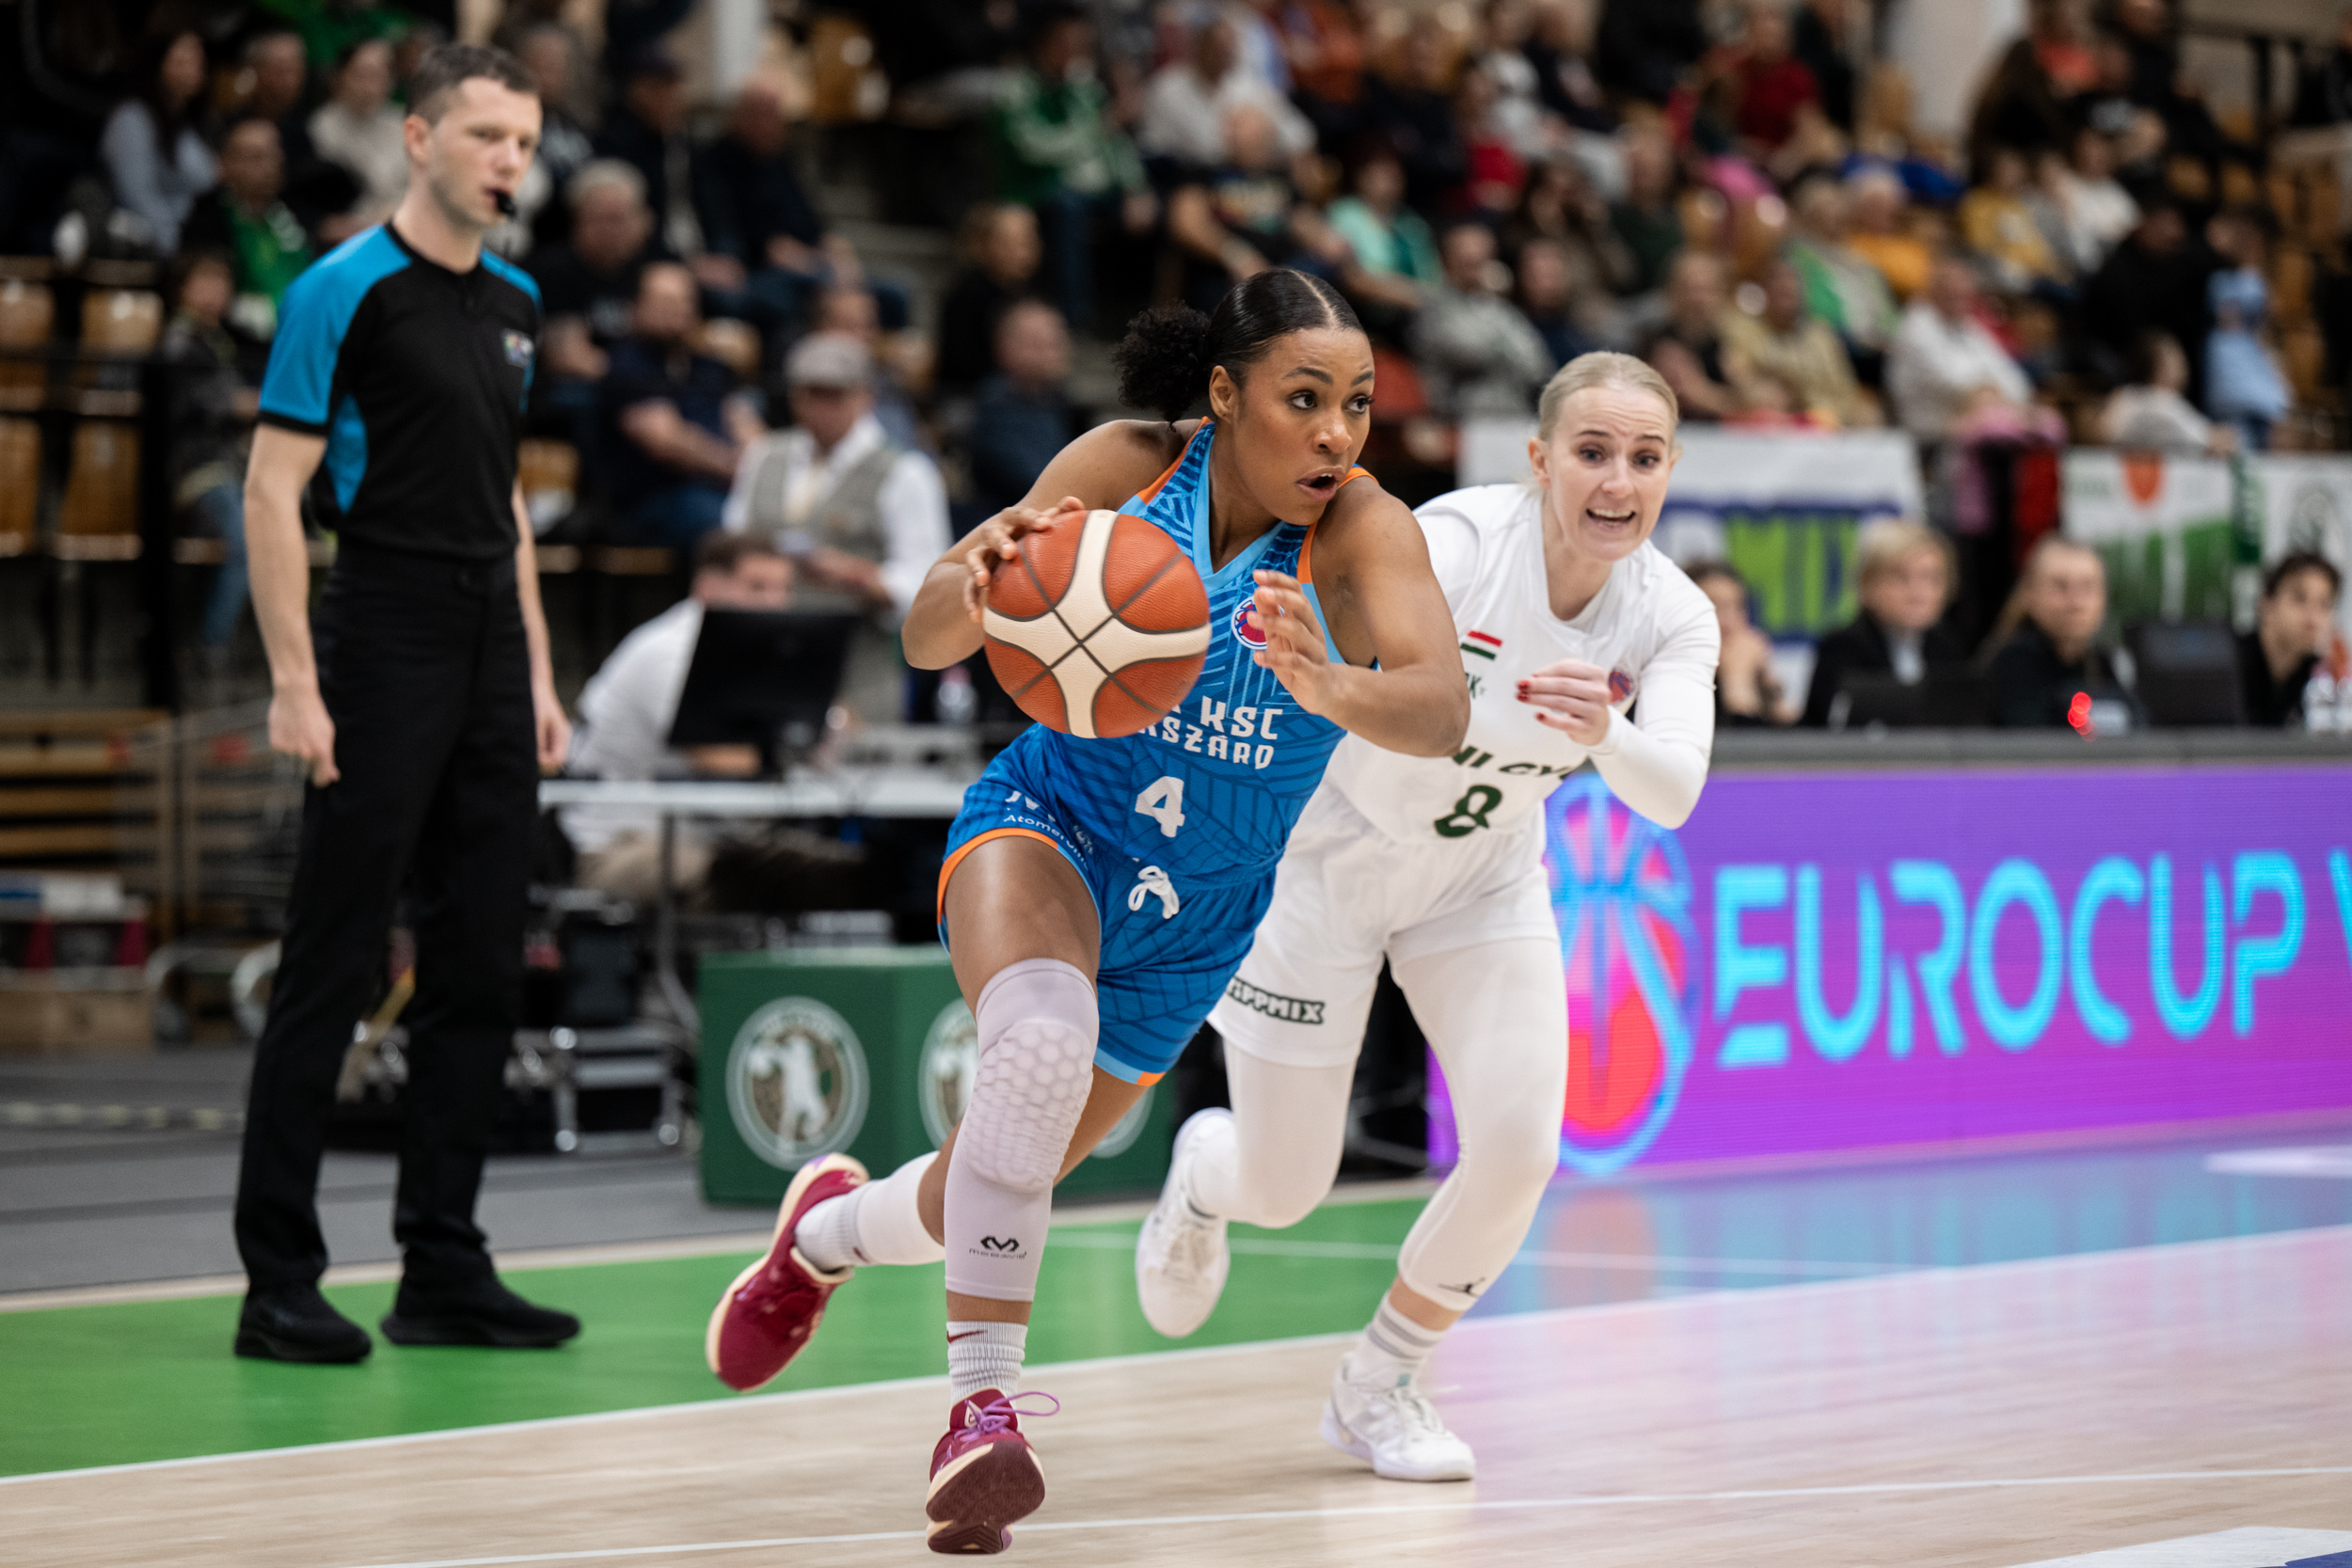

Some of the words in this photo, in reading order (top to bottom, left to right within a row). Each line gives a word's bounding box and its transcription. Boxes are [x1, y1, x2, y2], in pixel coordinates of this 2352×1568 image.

[1200, 695, 1283, 740] KSC
[1135, 776, 1185, 838] 4
[1434, 784, 1502, 838] 8
[1713, 848, 2307, 1069] EUROCUP
